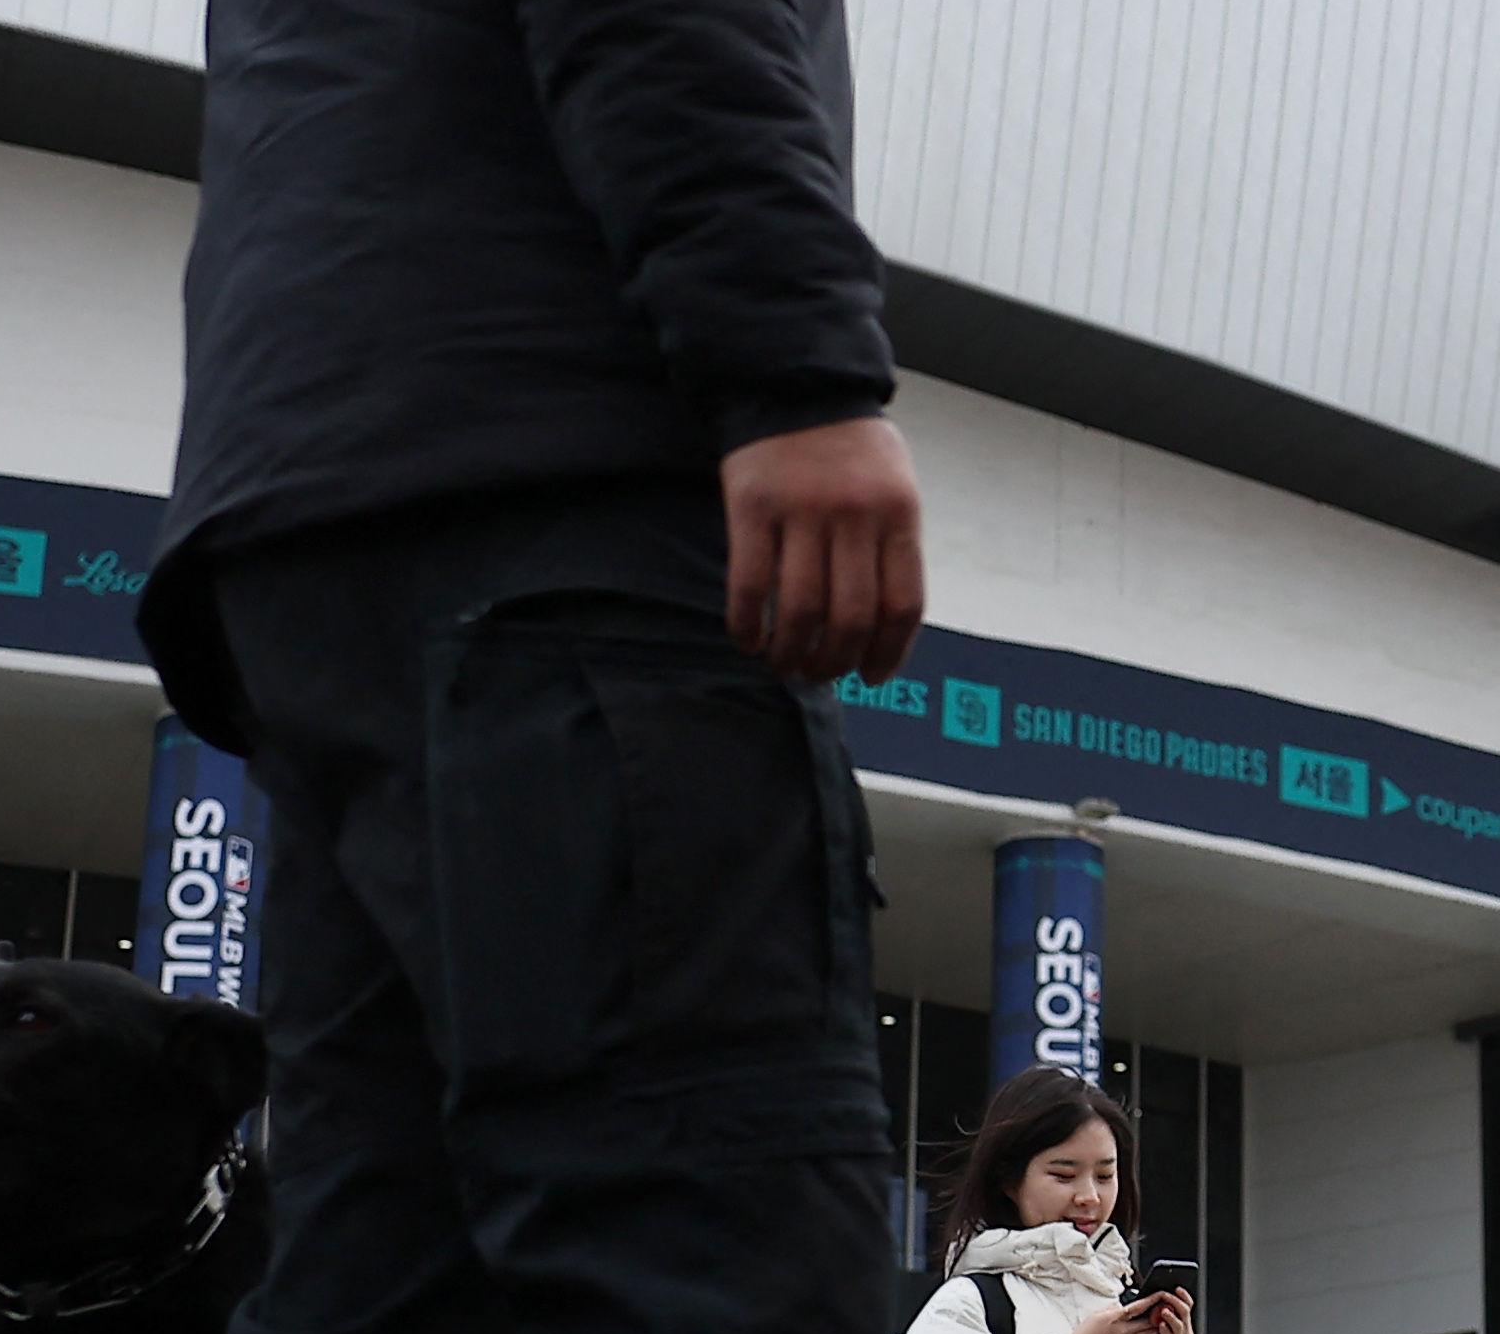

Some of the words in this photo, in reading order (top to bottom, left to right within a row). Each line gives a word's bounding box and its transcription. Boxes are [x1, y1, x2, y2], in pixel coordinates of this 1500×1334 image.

[1013, 703, 1073, 747] SAN
[1077, 713, 1162, 766] DIEGO
[1164, 730, 1268, 787] PADRES
[160, 797, 226, 996] SEOUL
[219, 891, 247, 965] MLB
[1035, 916, 1085, 1079] SEOU
